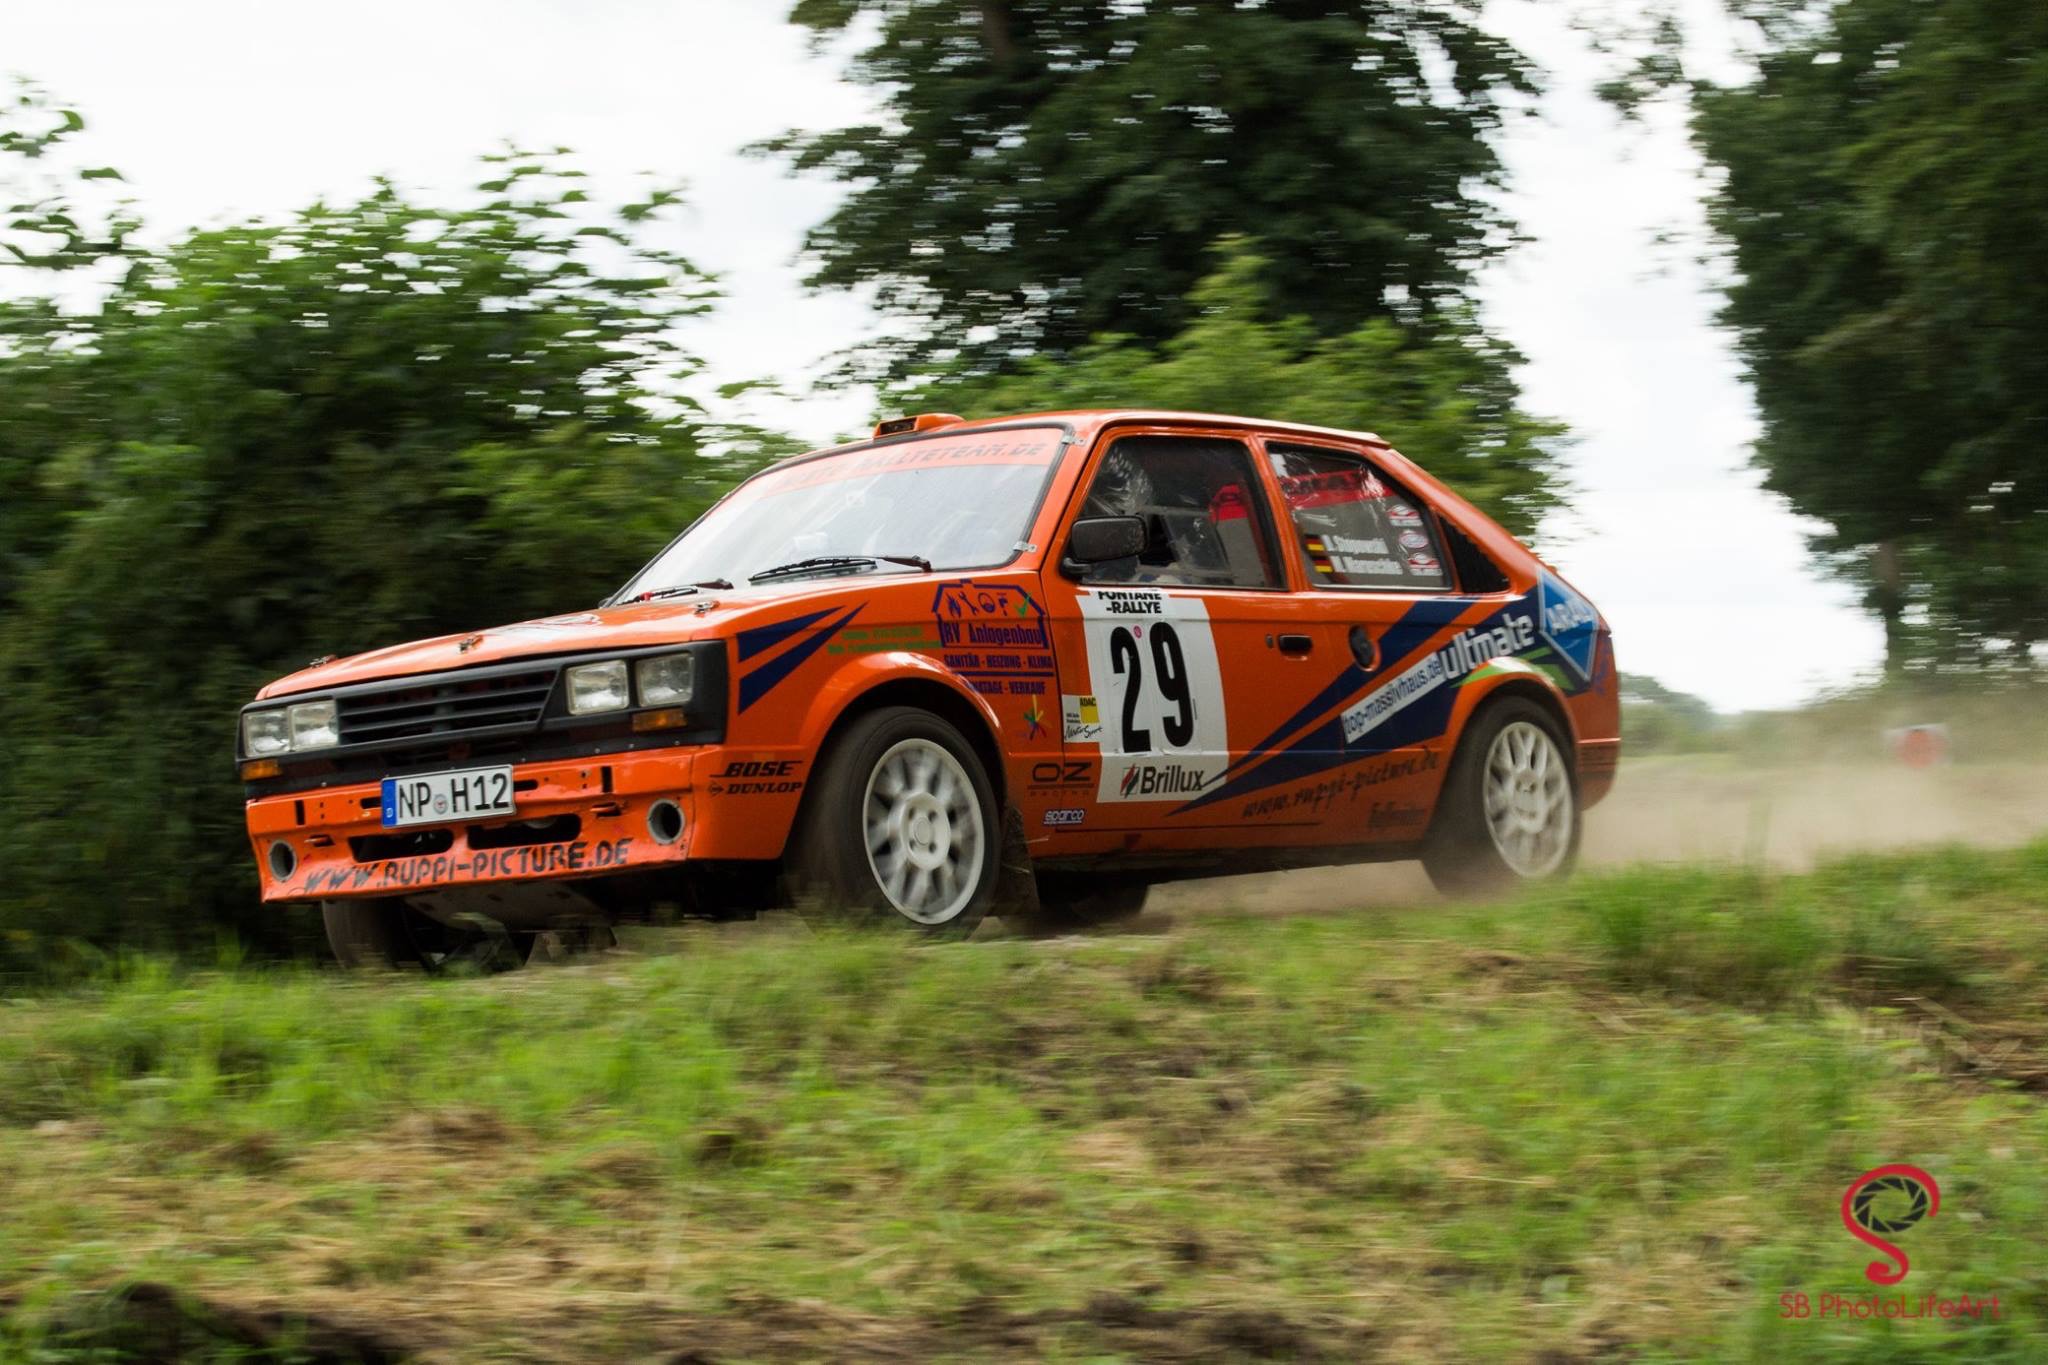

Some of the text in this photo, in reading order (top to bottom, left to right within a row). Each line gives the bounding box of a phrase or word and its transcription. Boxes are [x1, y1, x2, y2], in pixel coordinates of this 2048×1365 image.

[1106, 601, 1162, 613] -RALLYE
[1440, 612, 1535, 679] ultimate
[1110, 621, 1194, 753] 29
[725, 761, 802, 777] BOSE
[1032, 762, 1092, 782] OZ
[1139, 765, 1205, 794] Brillux
[399, 773, 509, 819] NP H12
[727, 782, 802, 794] DUNLOP
[303, 837, 632, 893] WWW.RUPPI-PICTURE.DE
